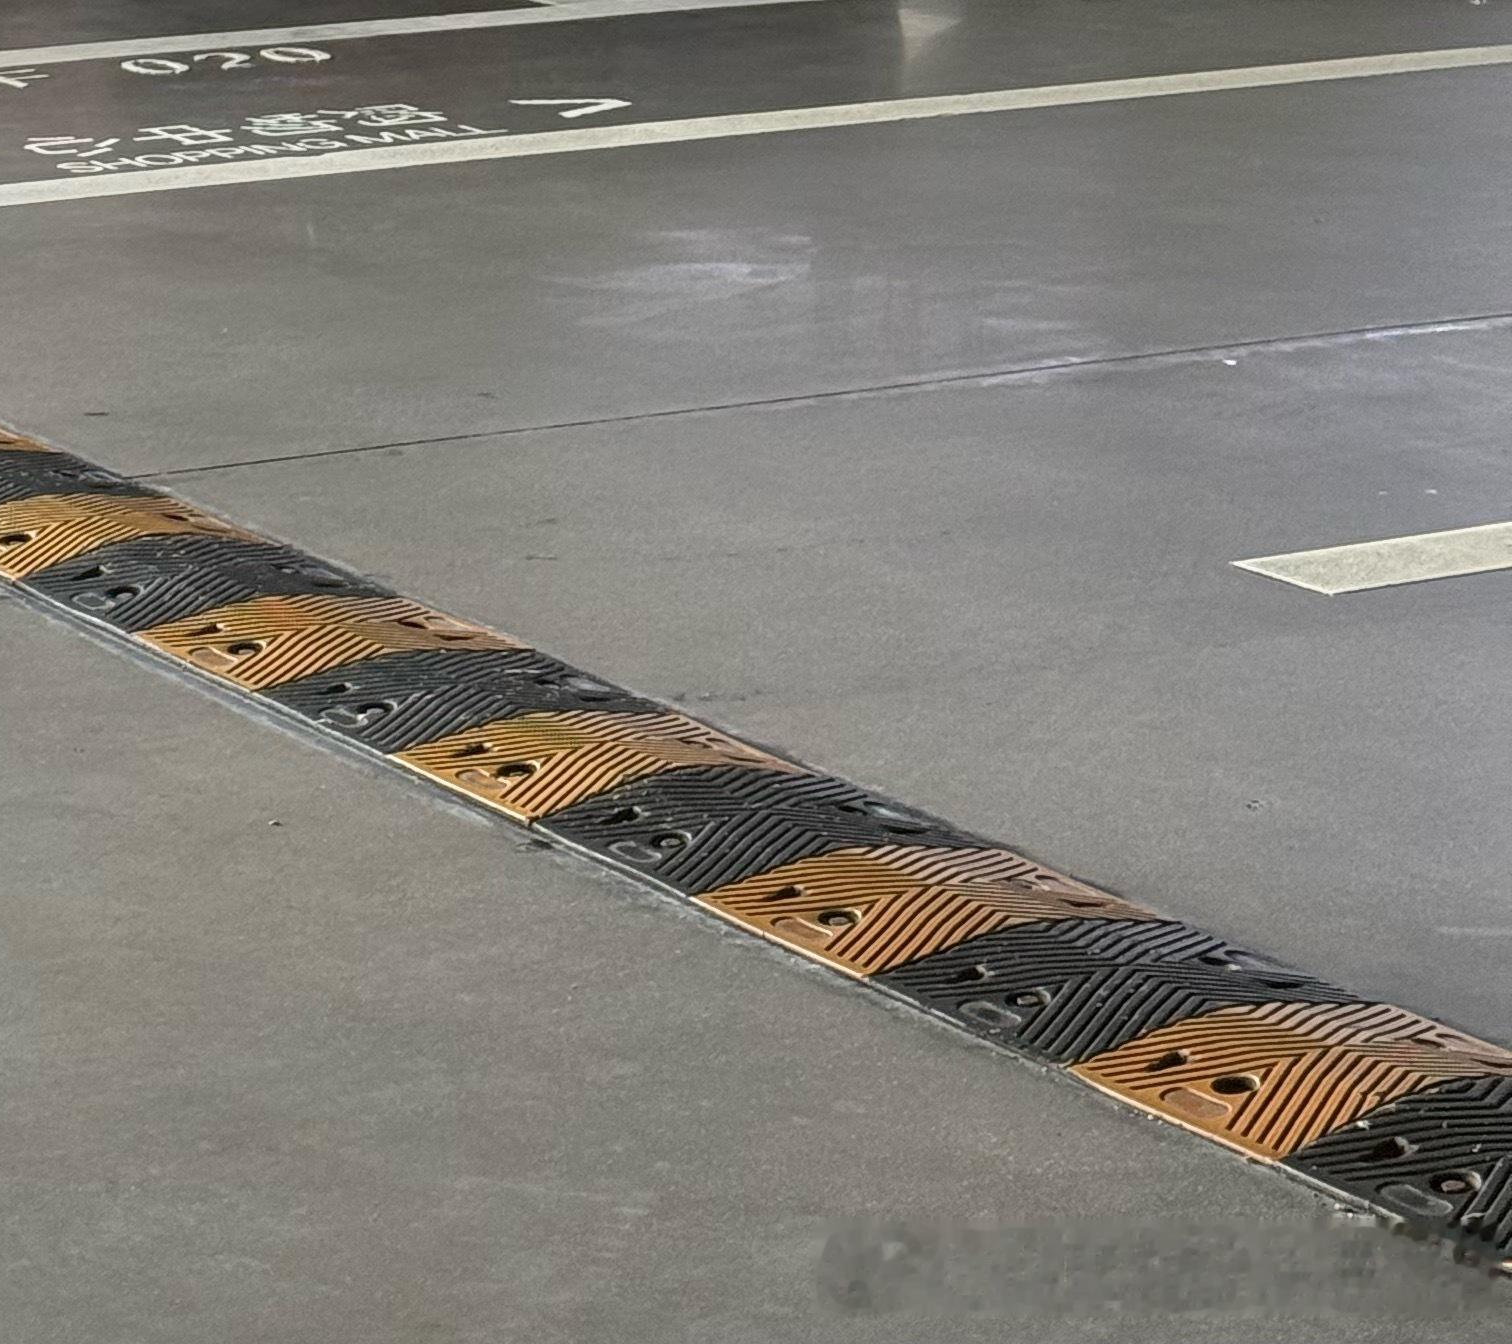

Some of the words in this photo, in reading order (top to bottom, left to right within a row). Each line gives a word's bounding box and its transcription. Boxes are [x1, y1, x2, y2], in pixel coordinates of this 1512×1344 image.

[119, 45, 332, 76] 020
[56, 128, 355, 176] SHOPPING
[348, 117, 509, 149] MALL
